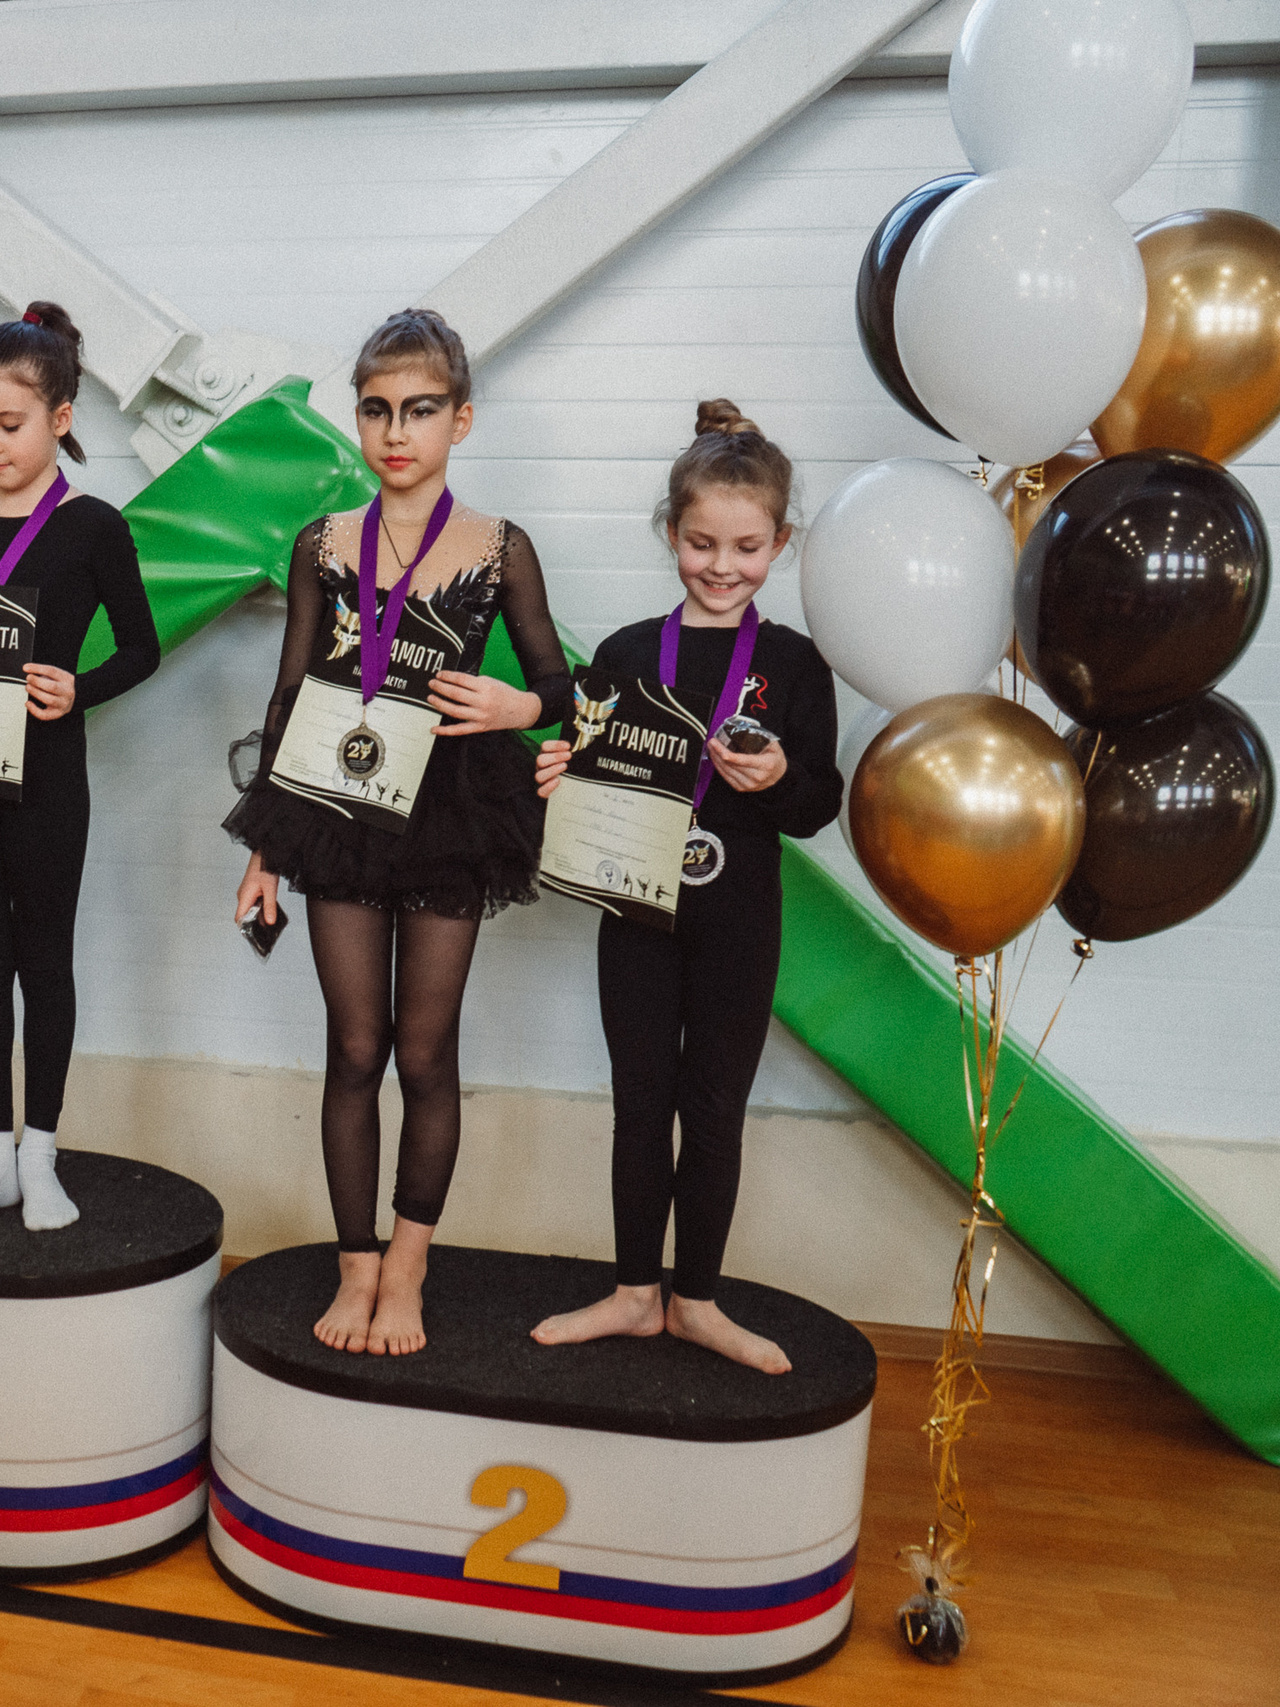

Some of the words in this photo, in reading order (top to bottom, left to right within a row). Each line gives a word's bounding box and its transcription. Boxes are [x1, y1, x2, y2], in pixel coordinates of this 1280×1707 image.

[377, 633, 445, 673] АМОТА
[347, 742, 360, 759] 2
[608, 721, 689, 764] ГРАМОТА
[596, 756, 652, 780] НАГРАЖДАЕТСЯ
[683, 848, 696, 865] 2
[463, 1465, 568, 1591] 2
